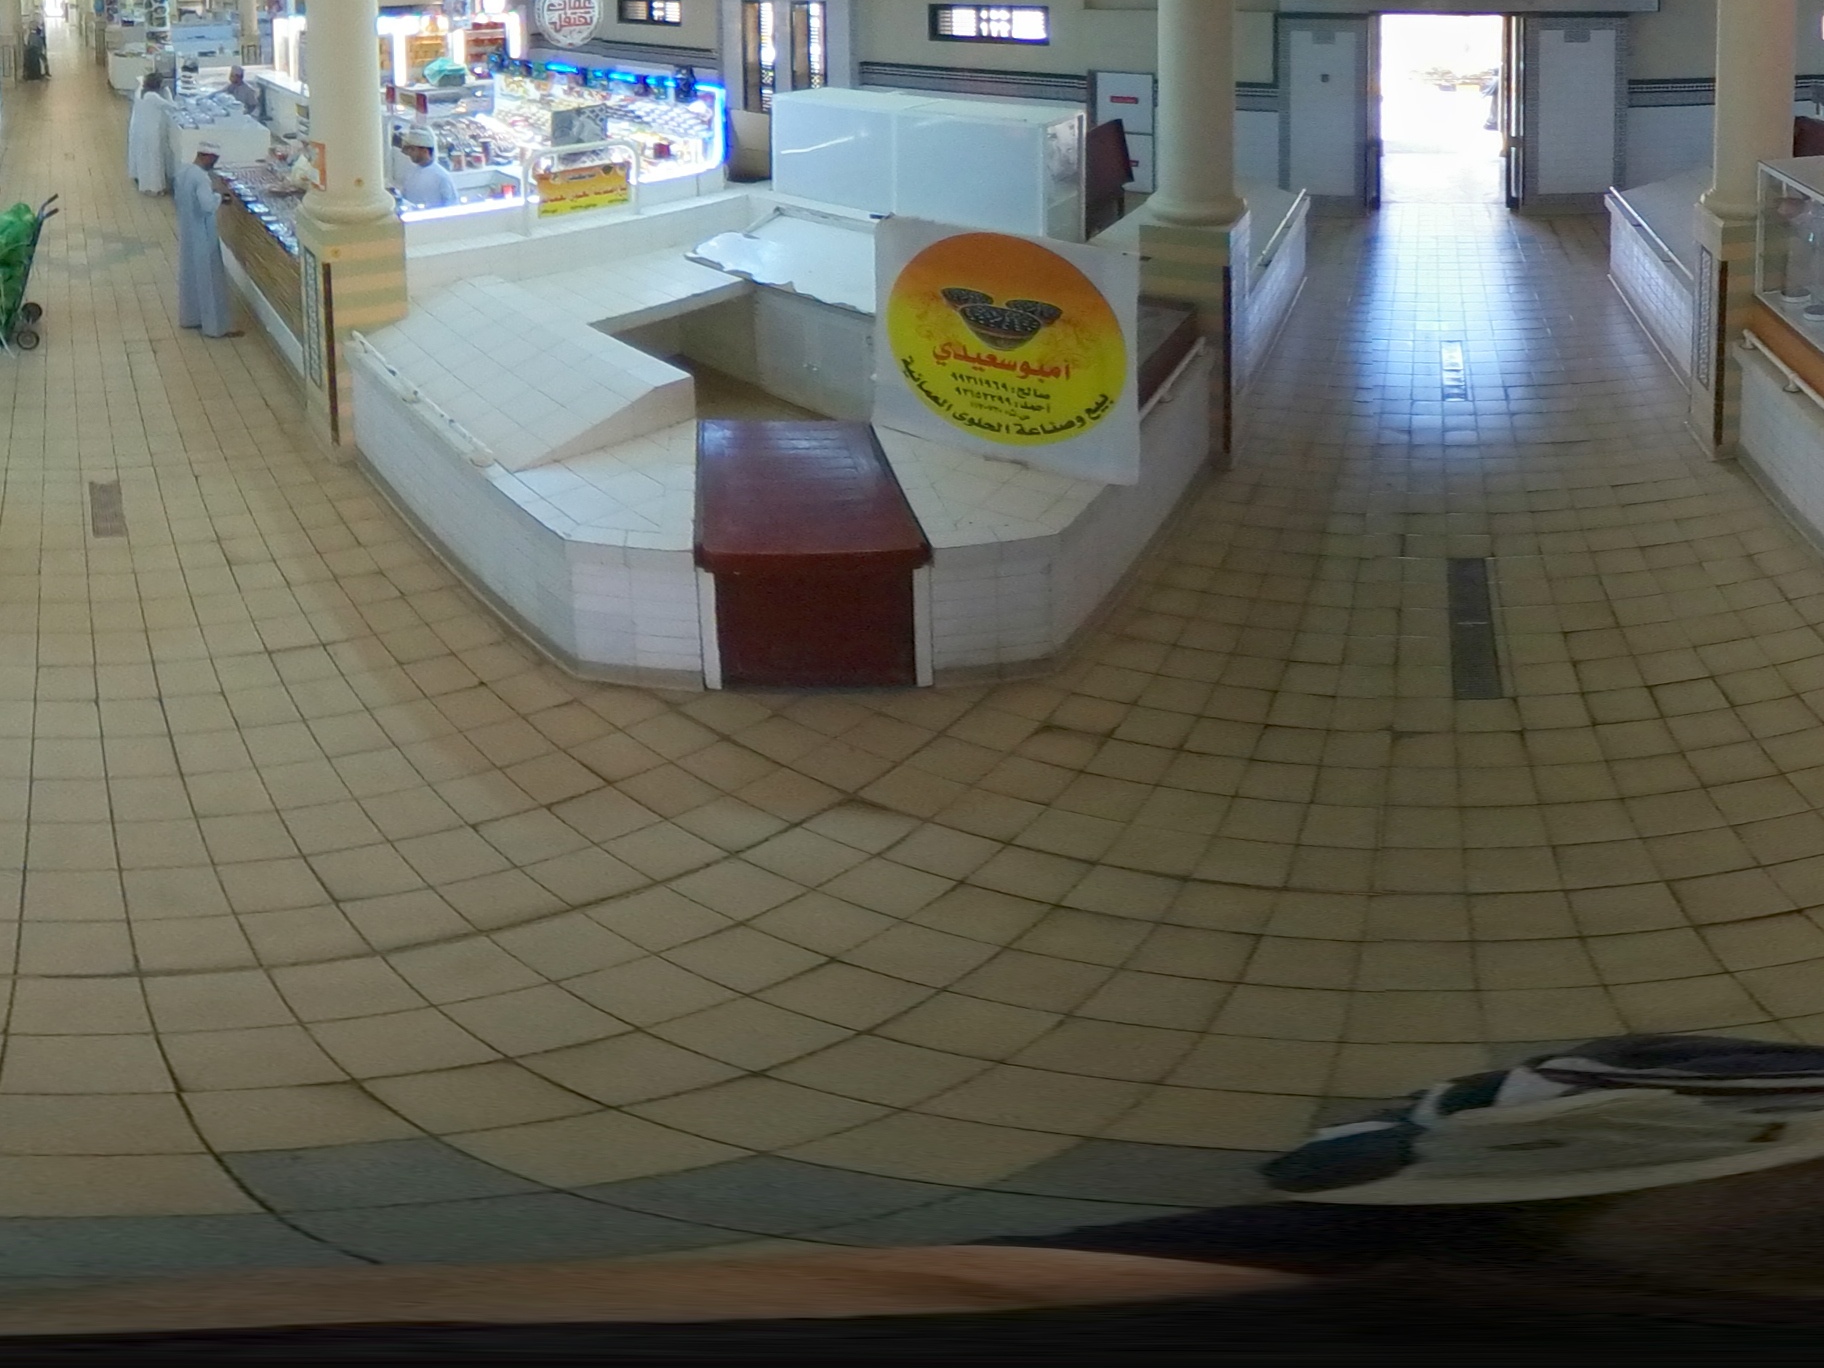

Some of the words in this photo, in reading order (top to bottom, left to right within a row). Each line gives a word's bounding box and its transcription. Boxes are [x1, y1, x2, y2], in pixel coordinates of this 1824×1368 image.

[900, 355, 953, 412] العمانية
[1084, 393, 1115, 421] بيع
[952, 410, 1010, 435] الحلوى
[1014, 414, 1087, 437] وصناعة
